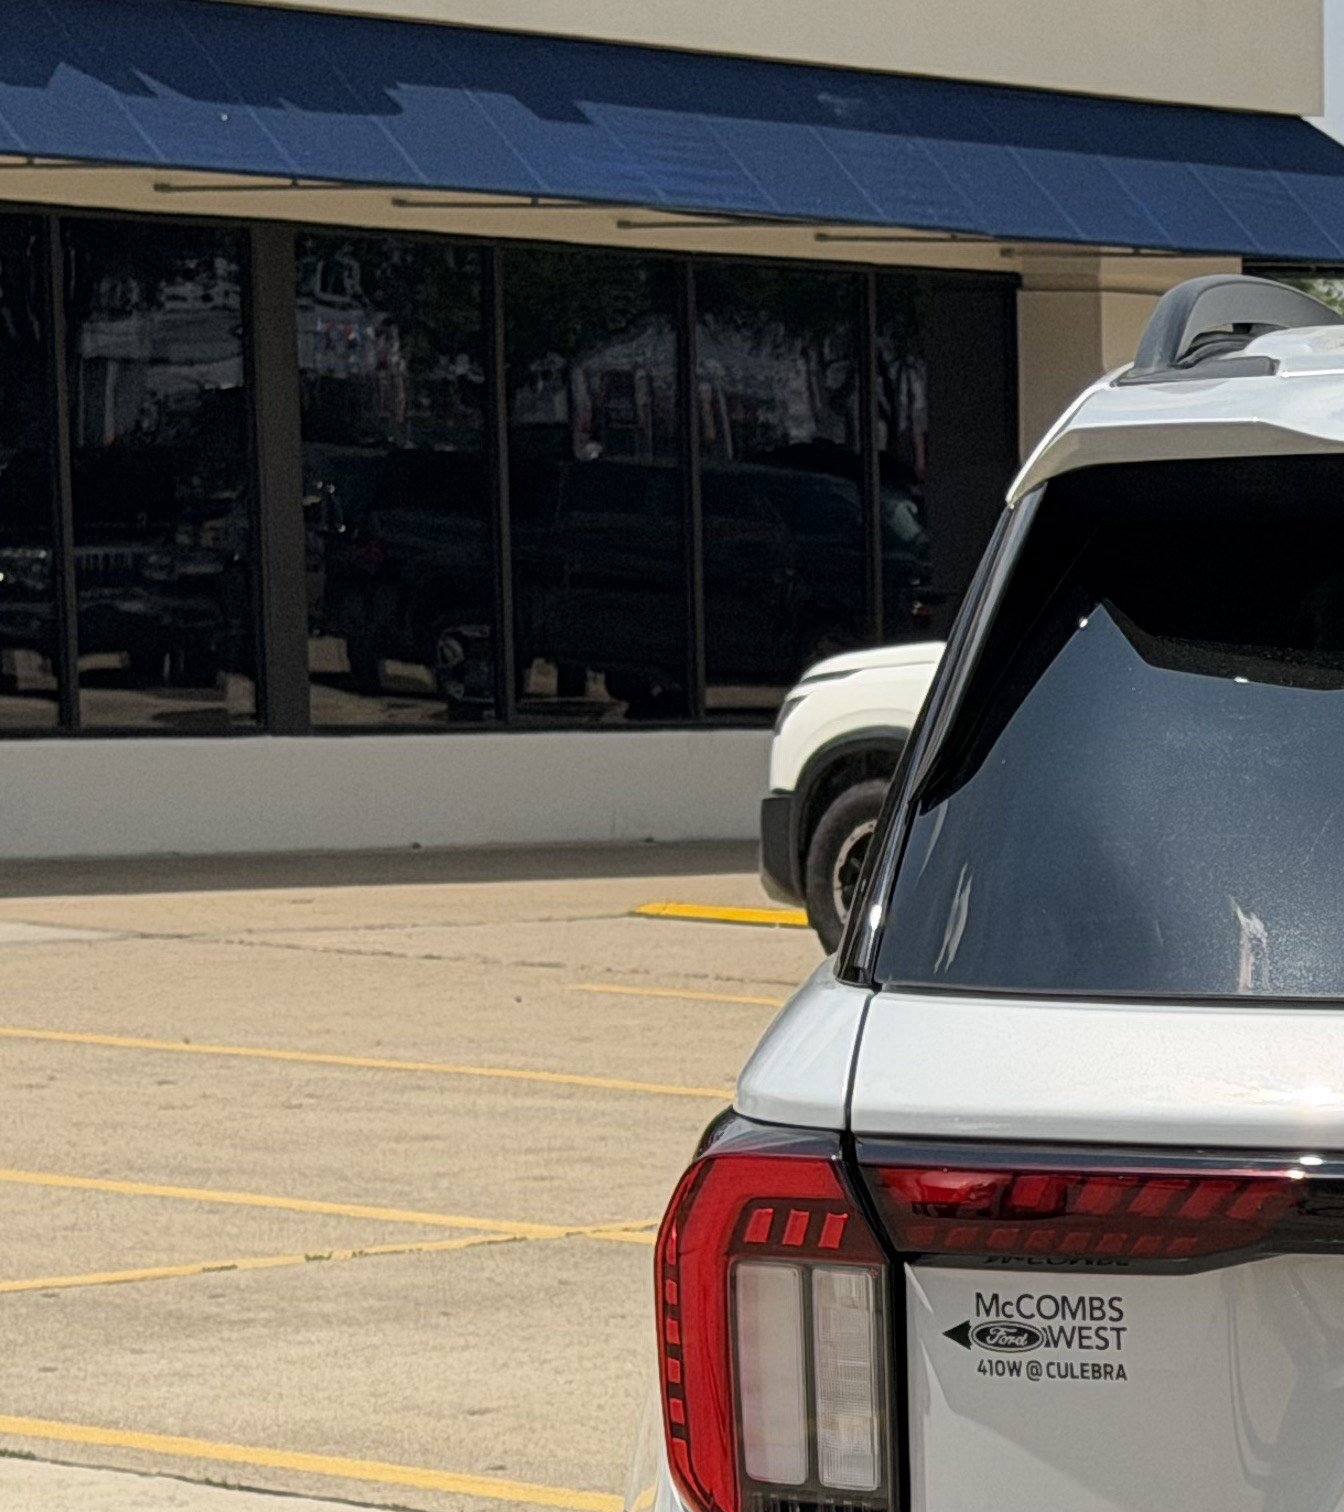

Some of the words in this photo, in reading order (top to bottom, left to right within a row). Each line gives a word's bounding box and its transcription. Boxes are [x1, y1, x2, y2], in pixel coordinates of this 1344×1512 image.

[974, 1292, 1124, 1322] McCOMBS
[985, 1326, 1030, 1347] Ford
[1043, 1325, 1127, 1351] WEST
[976, 1359, 1022, 1377] 410W
[1026, 1360, 1043, 1381] @
[1046, 1361, 1128, 1381] CULEBRA
